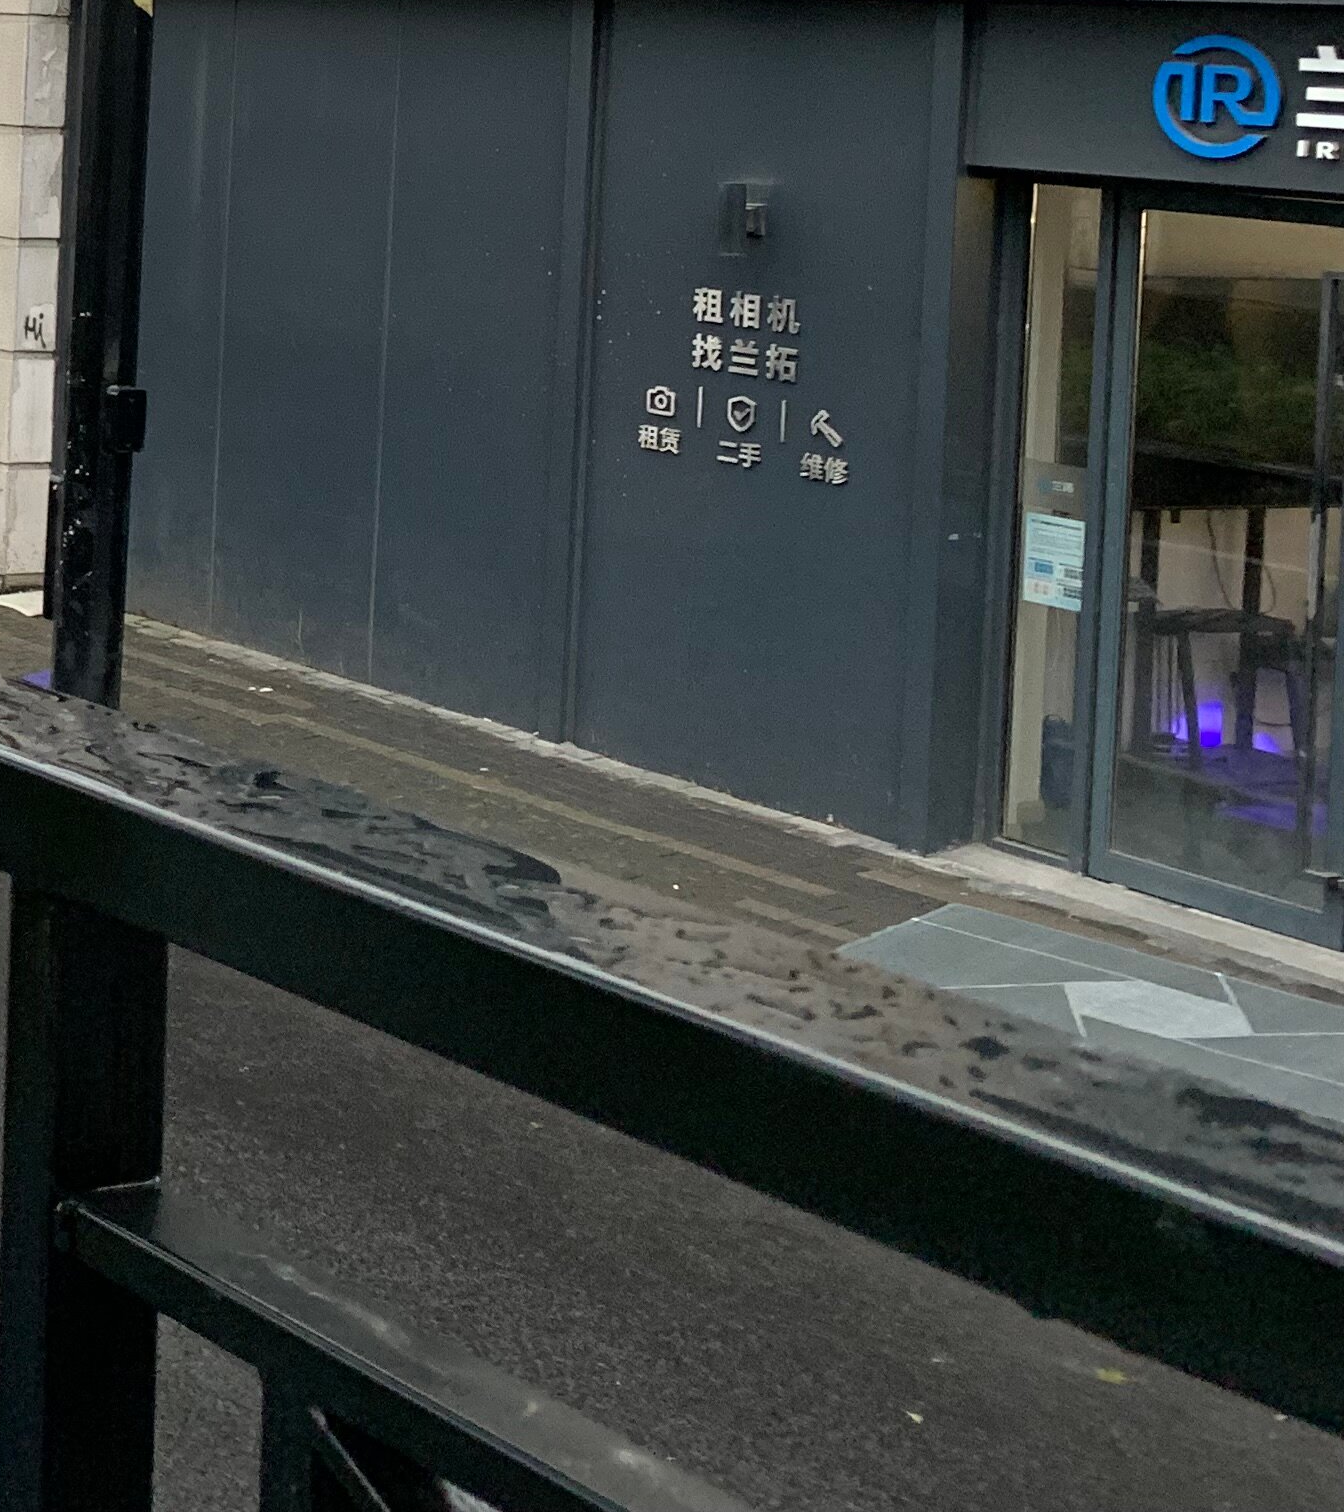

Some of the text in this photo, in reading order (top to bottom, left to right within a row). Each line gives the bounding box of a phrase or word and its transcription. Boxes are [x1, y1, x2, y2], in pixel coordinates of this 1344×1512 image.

[692, 286, 801, 335] 租相机
[691, 333, 799, 383] 找兰拓
[637, 424, 850, 486] 租赁 二手 维修
